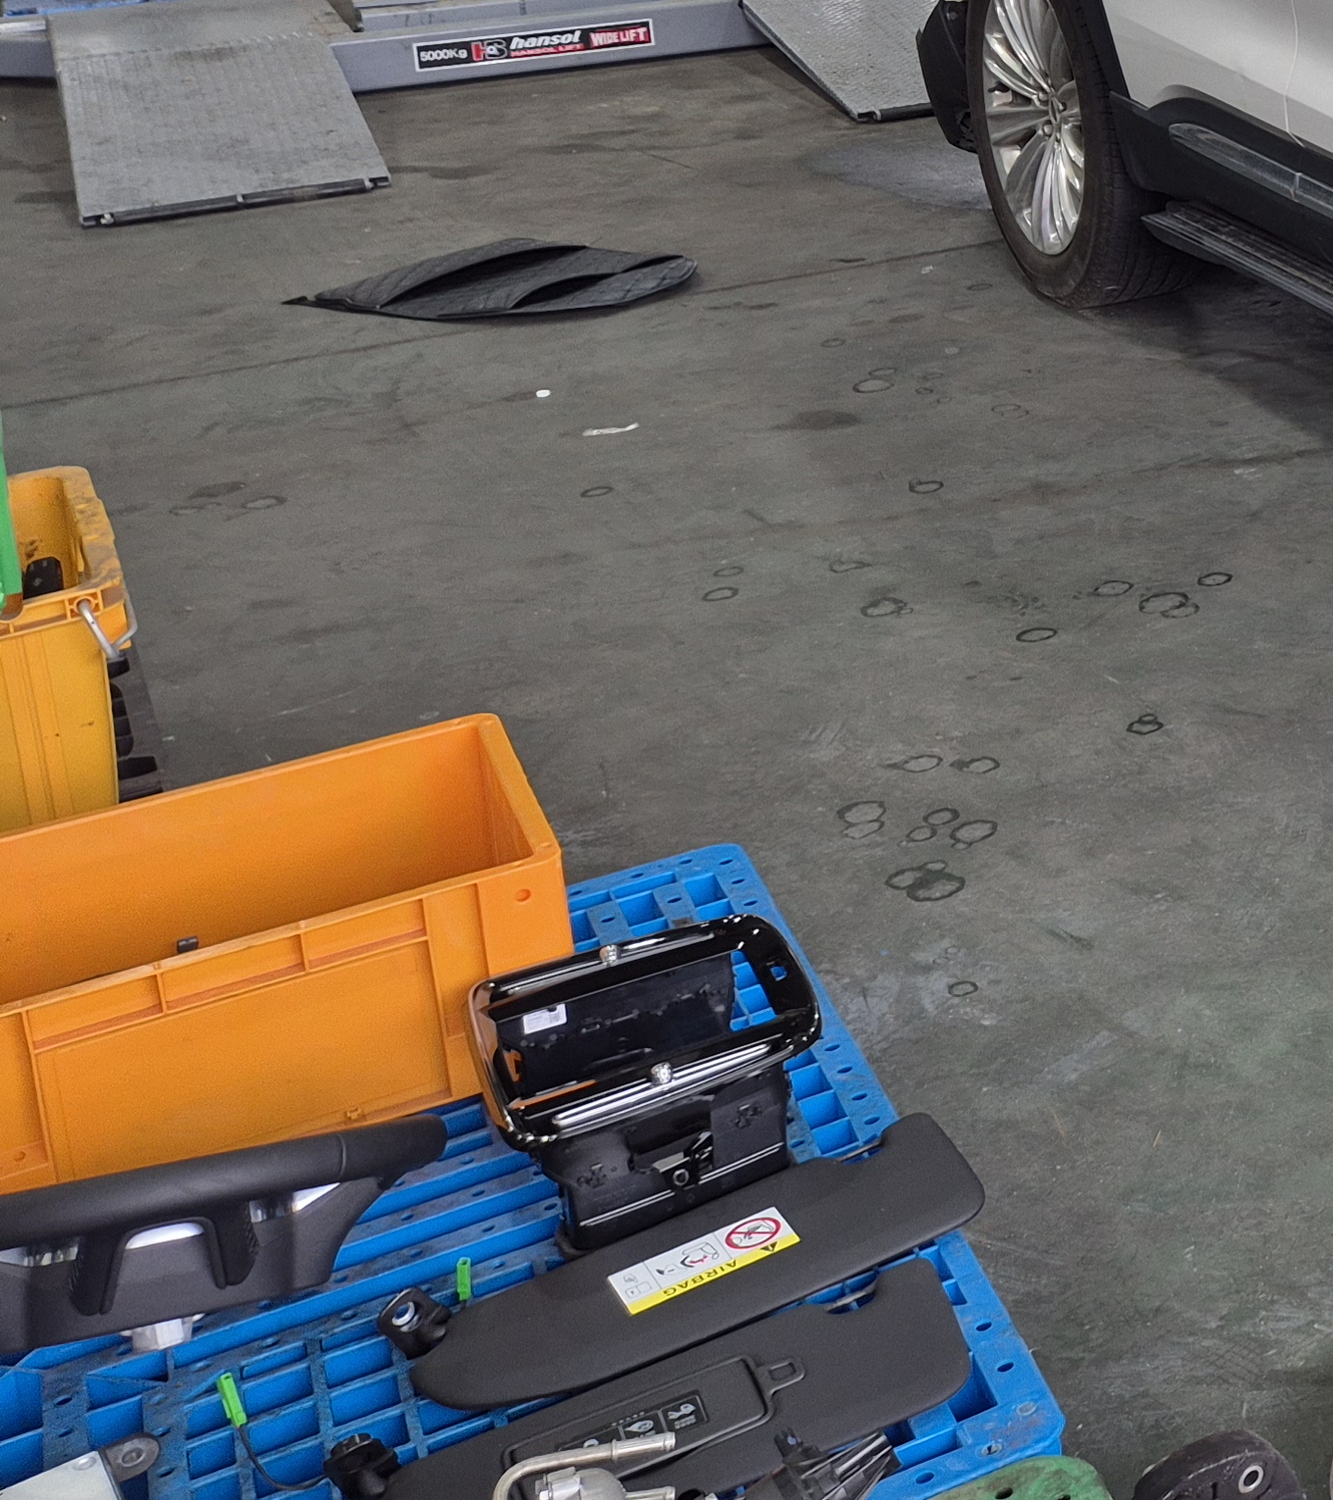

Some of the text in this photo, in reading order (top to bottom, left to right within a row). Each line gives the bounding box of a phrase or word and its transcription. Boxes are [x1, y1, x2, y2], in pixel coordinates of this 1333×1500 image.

[420, 49, 468, 62] 5000Kg
[510, 30, 582, 50] hansol
[590, 30, 621, 48] WIDE
[622, 27, 648, 44] LIFT
[663, 1259, 737, 1296] AIRBAG
